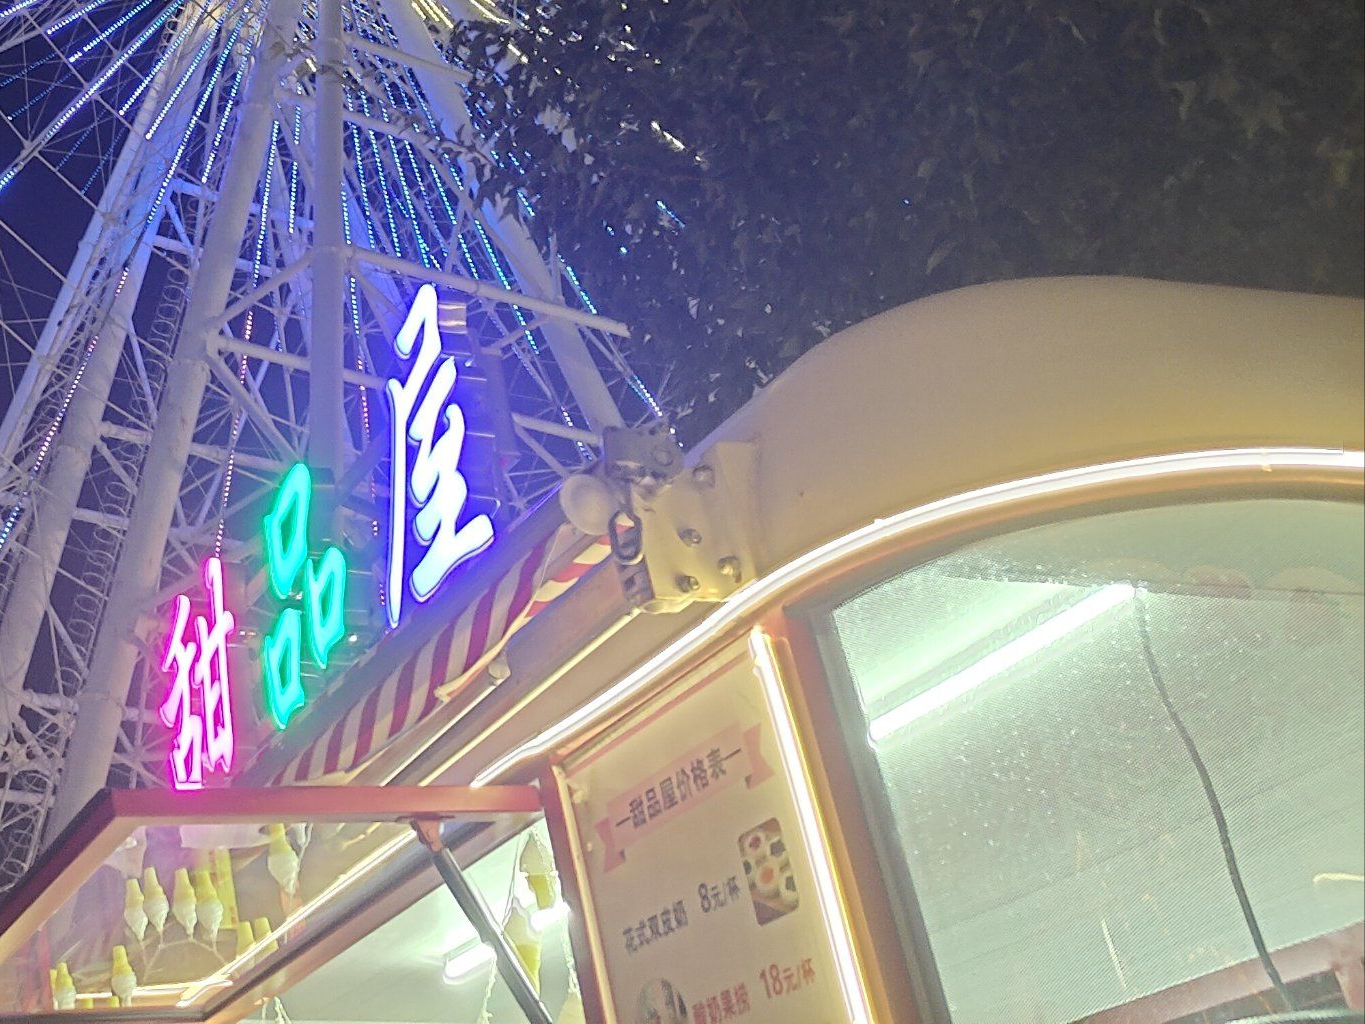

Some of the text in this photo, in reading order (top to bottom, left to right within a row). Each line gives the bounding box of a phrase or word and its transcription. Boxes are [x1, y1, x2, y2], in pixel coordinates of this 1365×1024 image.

[160, 283, 495, 790] 甜品屋
[759, 957, 816, 999] 18元/杯
